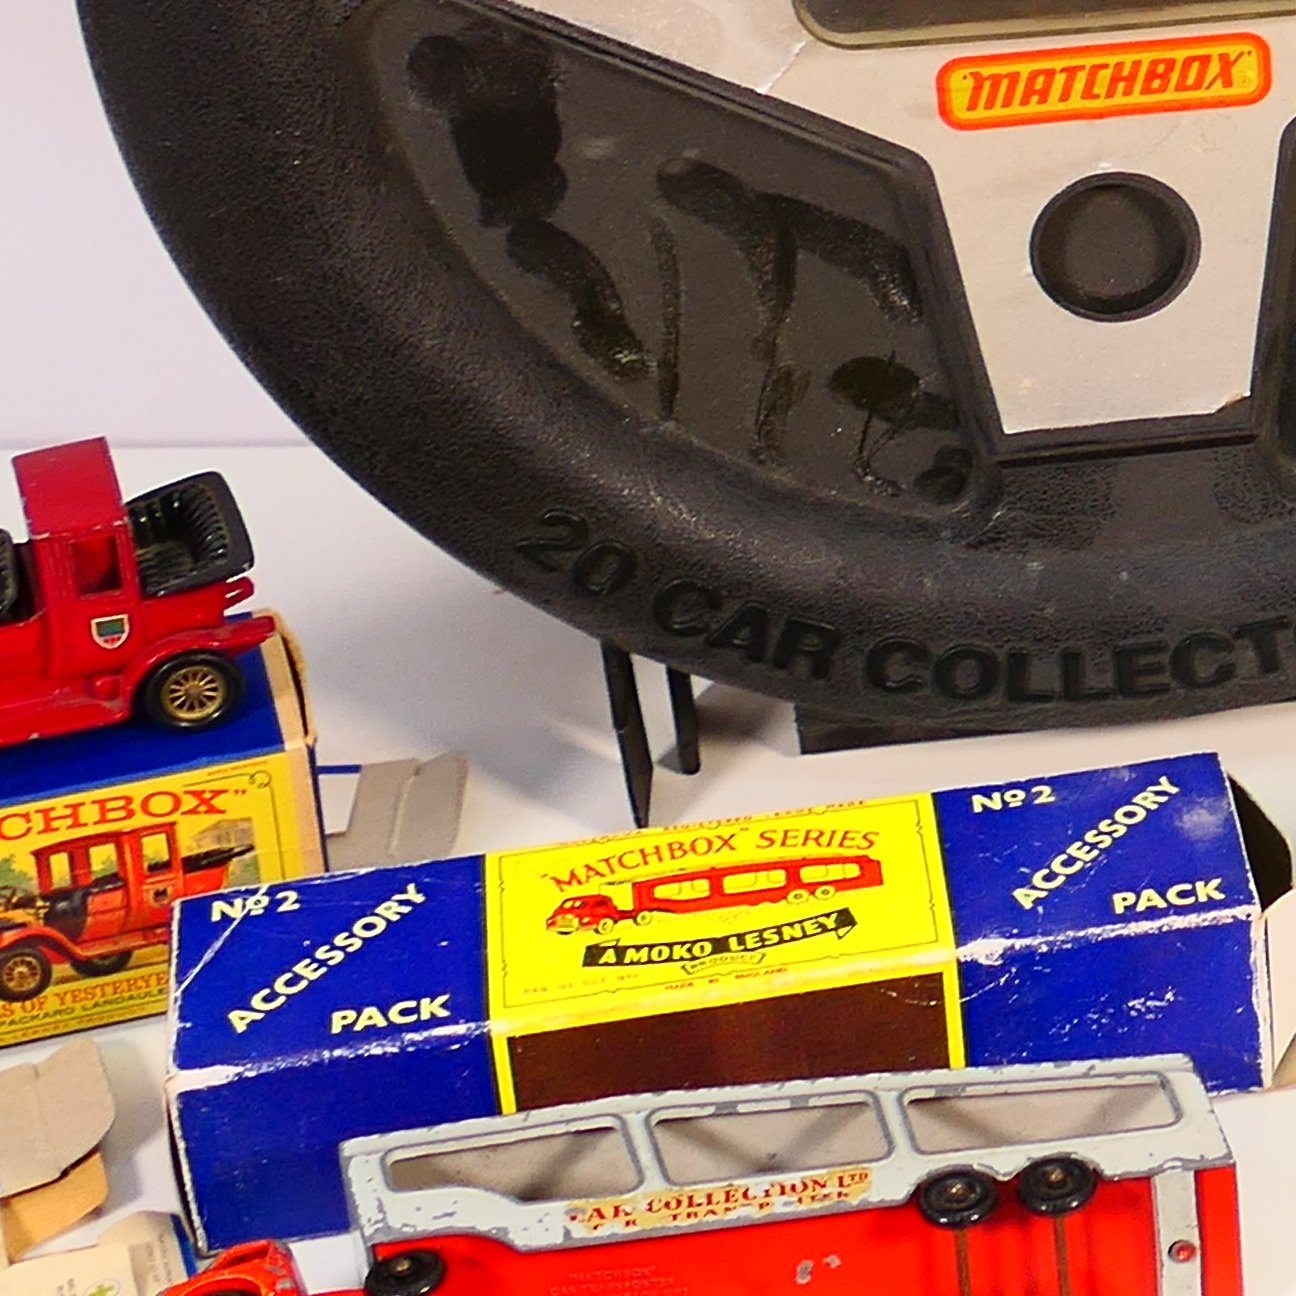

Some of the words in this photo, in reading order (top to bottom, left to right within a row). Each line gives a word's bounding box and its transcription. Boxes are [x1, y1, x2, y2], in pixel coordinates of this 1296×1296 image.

[965, 51, 1246, 112] MATCHBOX
[514, 504, 638, 599] 20
[650, 577, 842, 681] CAR
[756, 828, 880, 852] SERIES
[1009, 776, 1182, 911] ACCESSORY
[1112, 878, 1226, 915] PACK
[226, 883, 427, 1035] ACCESSORY
[599, 947, 617, 965] A
[623, 940, 714, 964] MOKO
[729, 912, 840, 952] LESNEY
[330, 992, 452, 1036] PACK
[645, 1177, 828, 1216] COLLECTION
